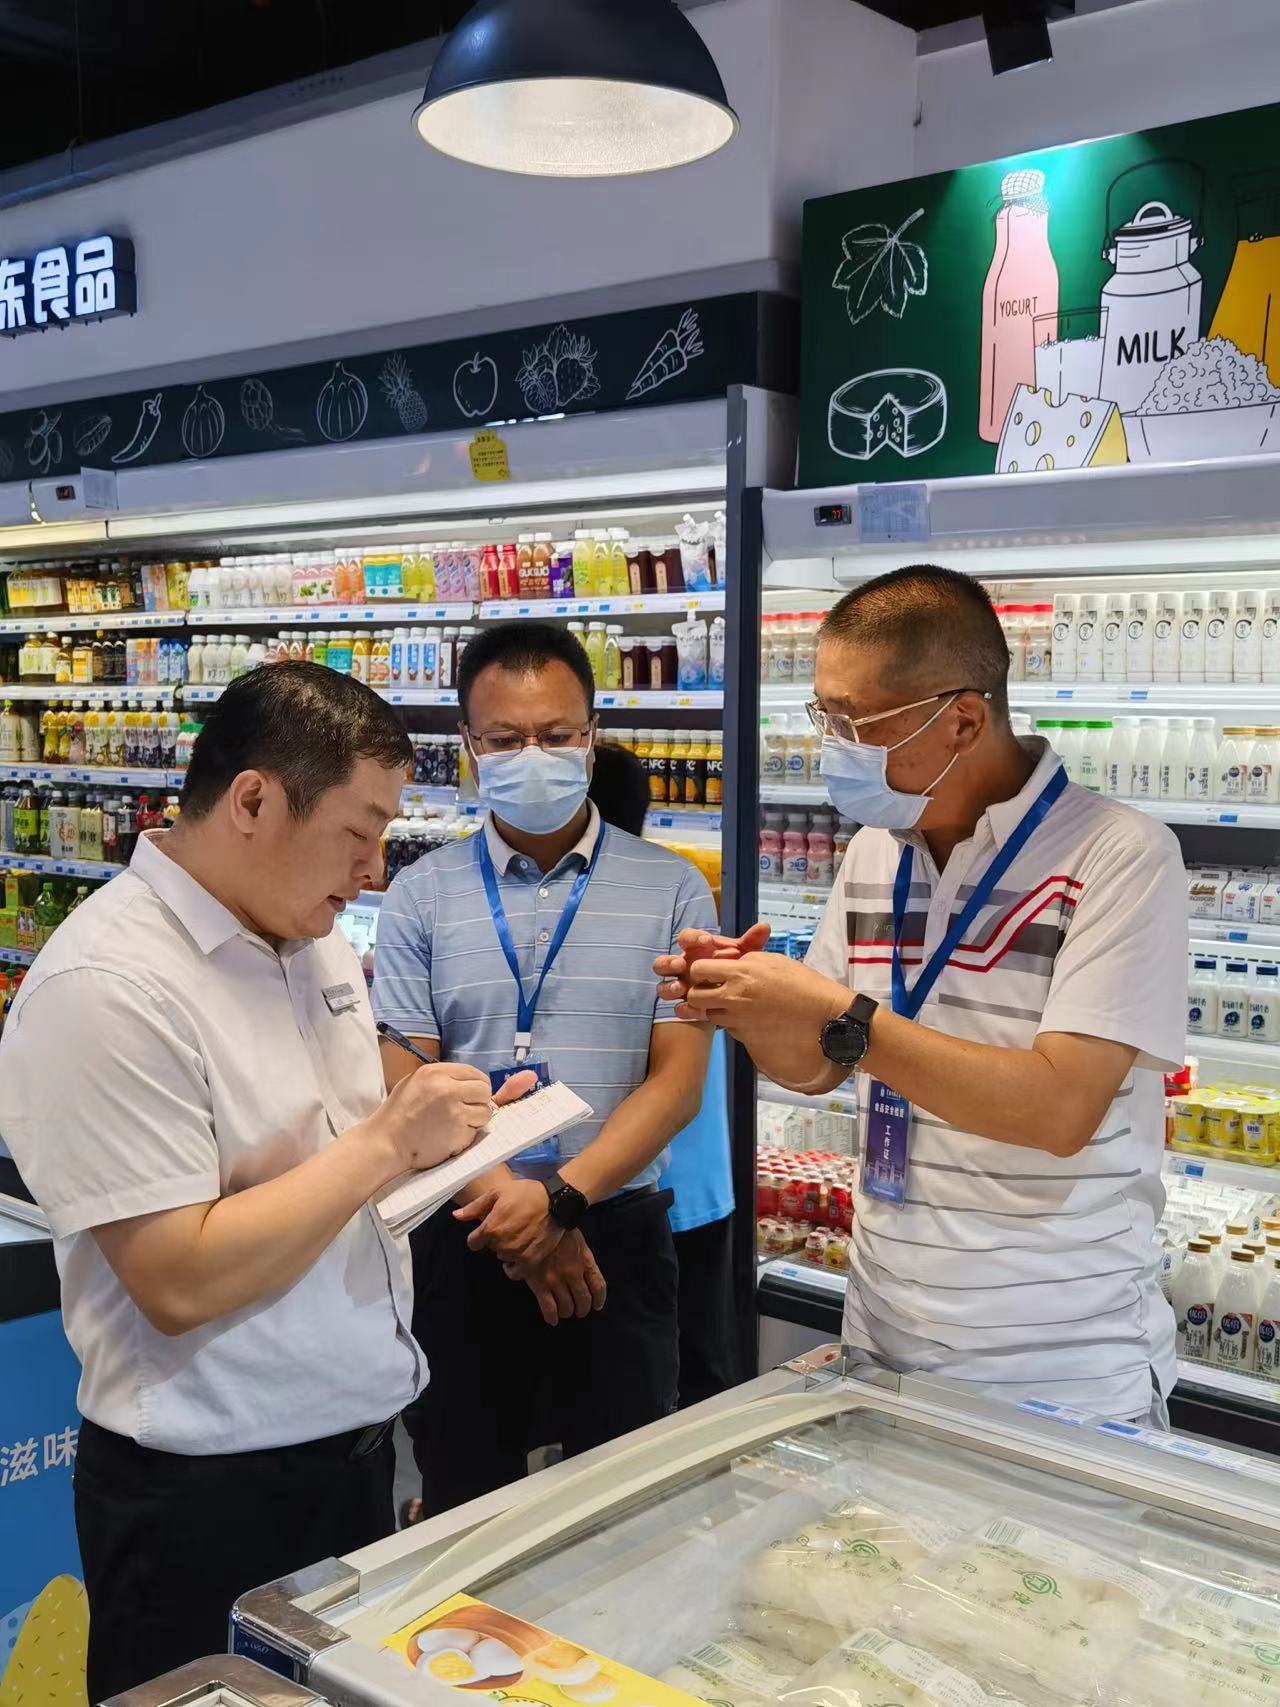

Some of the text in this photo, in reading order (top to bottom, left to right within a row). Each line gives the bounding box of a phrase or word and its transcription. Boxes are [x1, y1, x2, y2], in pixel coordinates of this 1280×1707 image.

[1000, 296, 1038, 318] YOGURT
[1117, 326, 1186, 367] MILK
[649, 759, 666, 770] NFC
[707, 760, 723, 772] NFC
[883, 1125, 892, 1160] 工作证
[0, 1426, 78, 1485] 滋味
